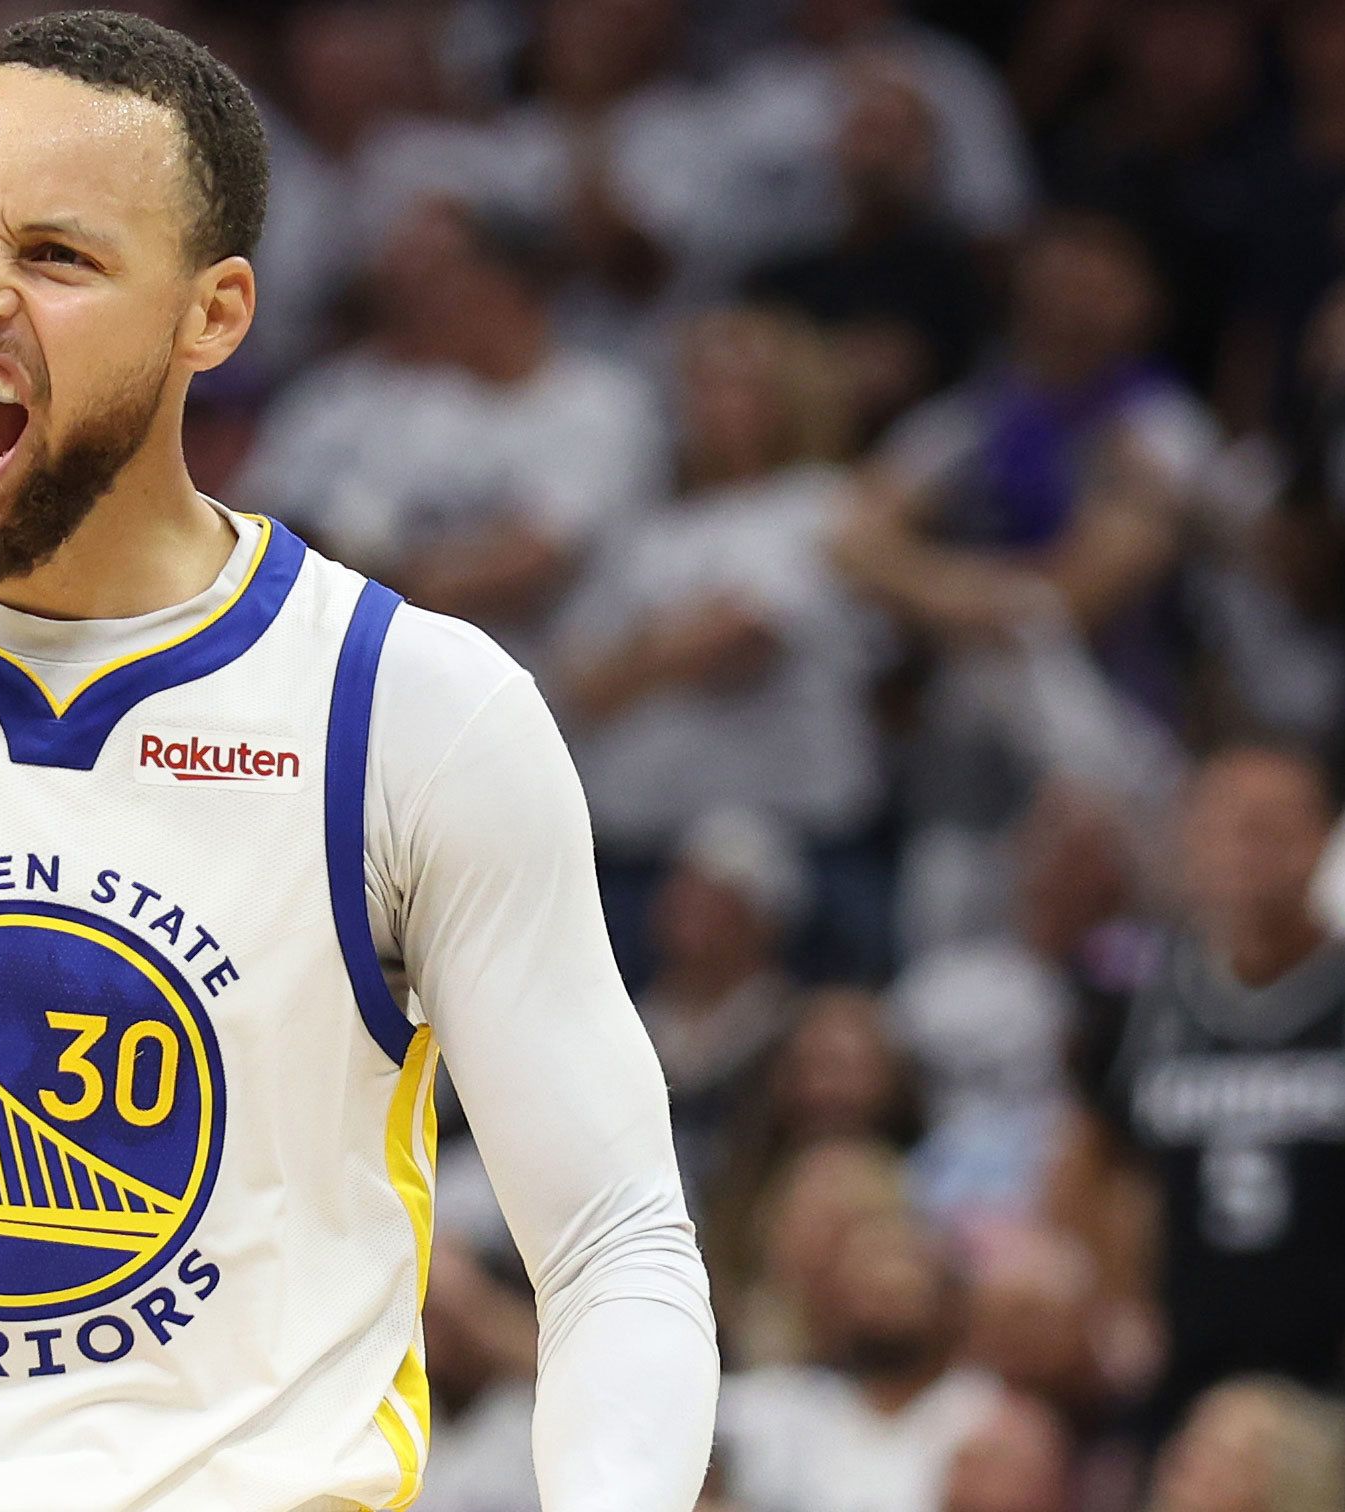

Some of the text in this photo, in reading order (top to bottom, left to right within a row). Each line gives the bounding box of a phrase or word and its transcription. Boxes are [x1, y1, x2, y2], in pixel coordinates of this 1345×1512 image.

[140, 734, 301, 778] Rakuten
[90, 869, 241, 998] STATE
[37, 1010, 179, 1127] 30
